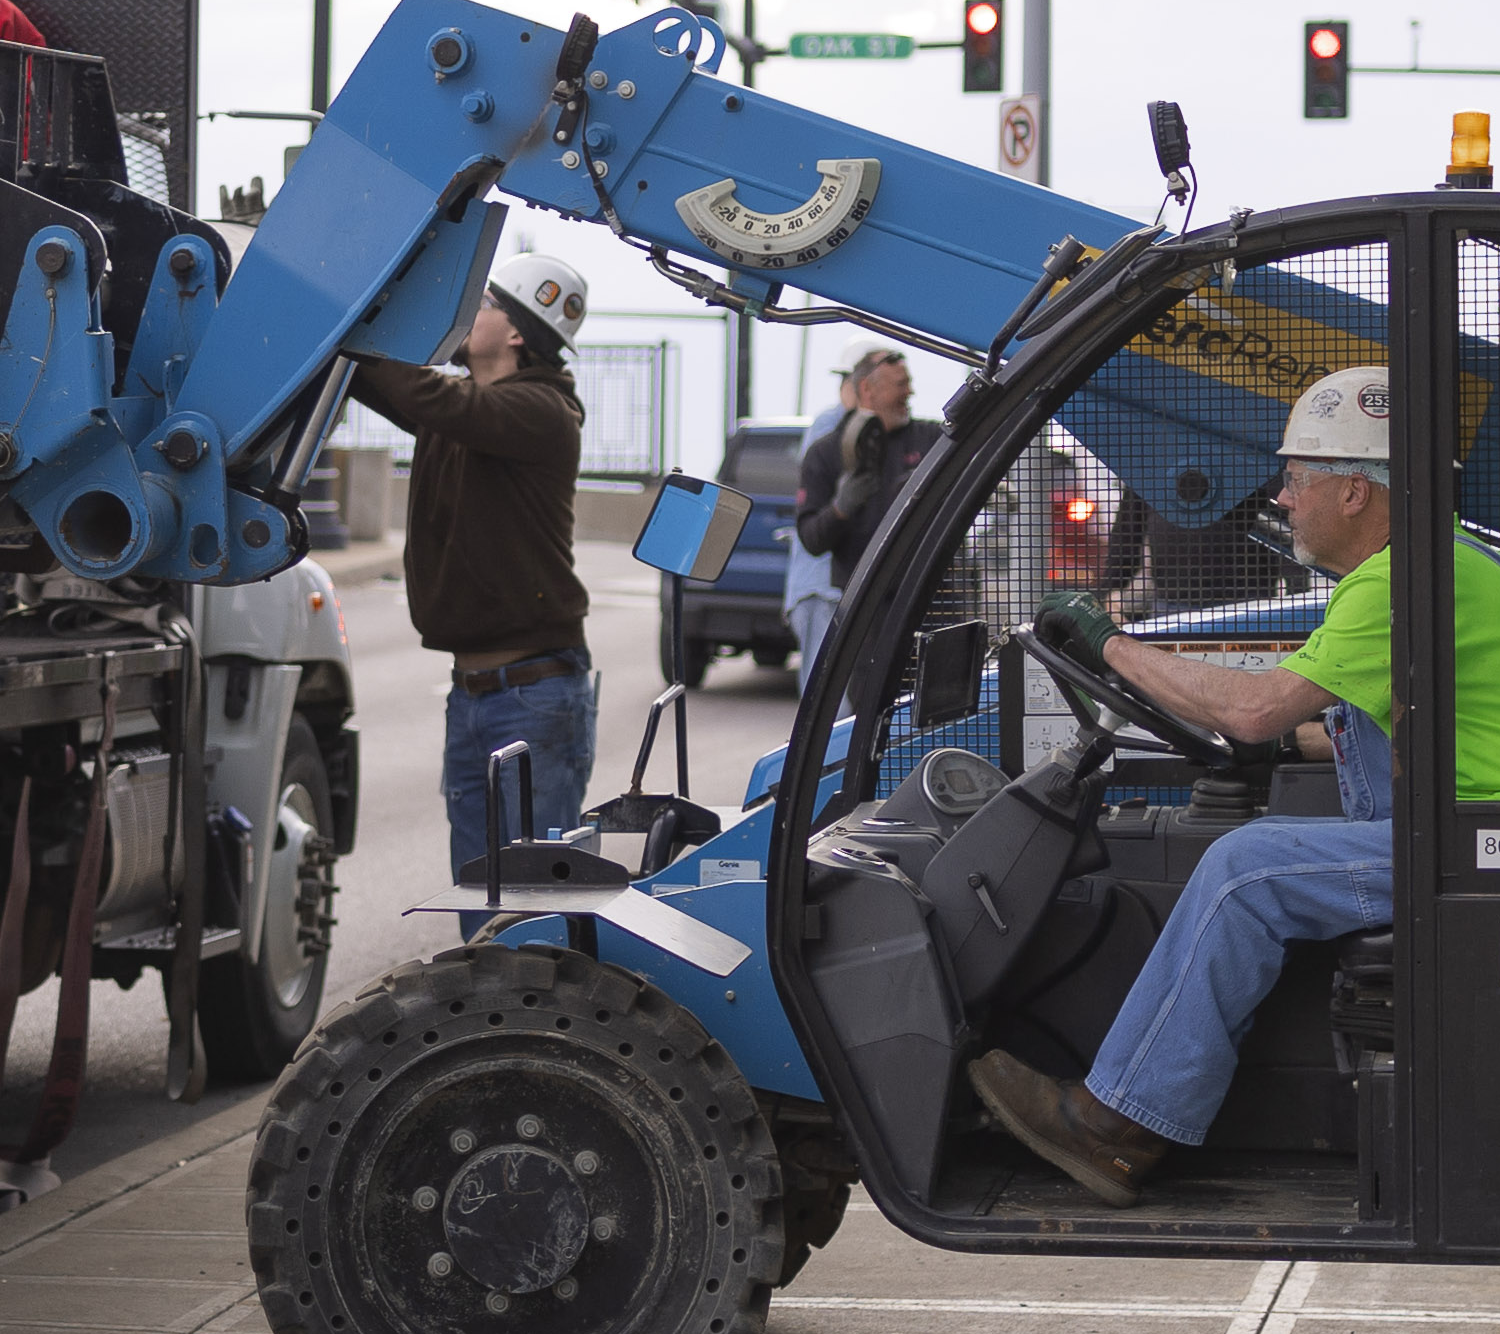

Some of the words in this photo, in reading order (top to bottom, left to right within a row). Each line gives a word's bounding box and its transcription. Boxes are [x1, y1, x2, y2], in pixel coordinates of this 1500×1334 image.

[804, 36, 856, 57] OAK
[869, 36, 898, 58] ST
[718, 206, 737, 223] -20
[745, 220, 754, 231] 0
[764, 224, 780, 234] 20
[787, 218, 803, 231] 40
[807, 205, 823, 220] 60
[823, 185, 837, 202] 80
[732, 251, 743, 263] 0
[761, 257, 784, 268] 20
[796, 247, 819, 263] 40
[826, 227, 849, 248] 60
[851, 198, 870, 222] 80
